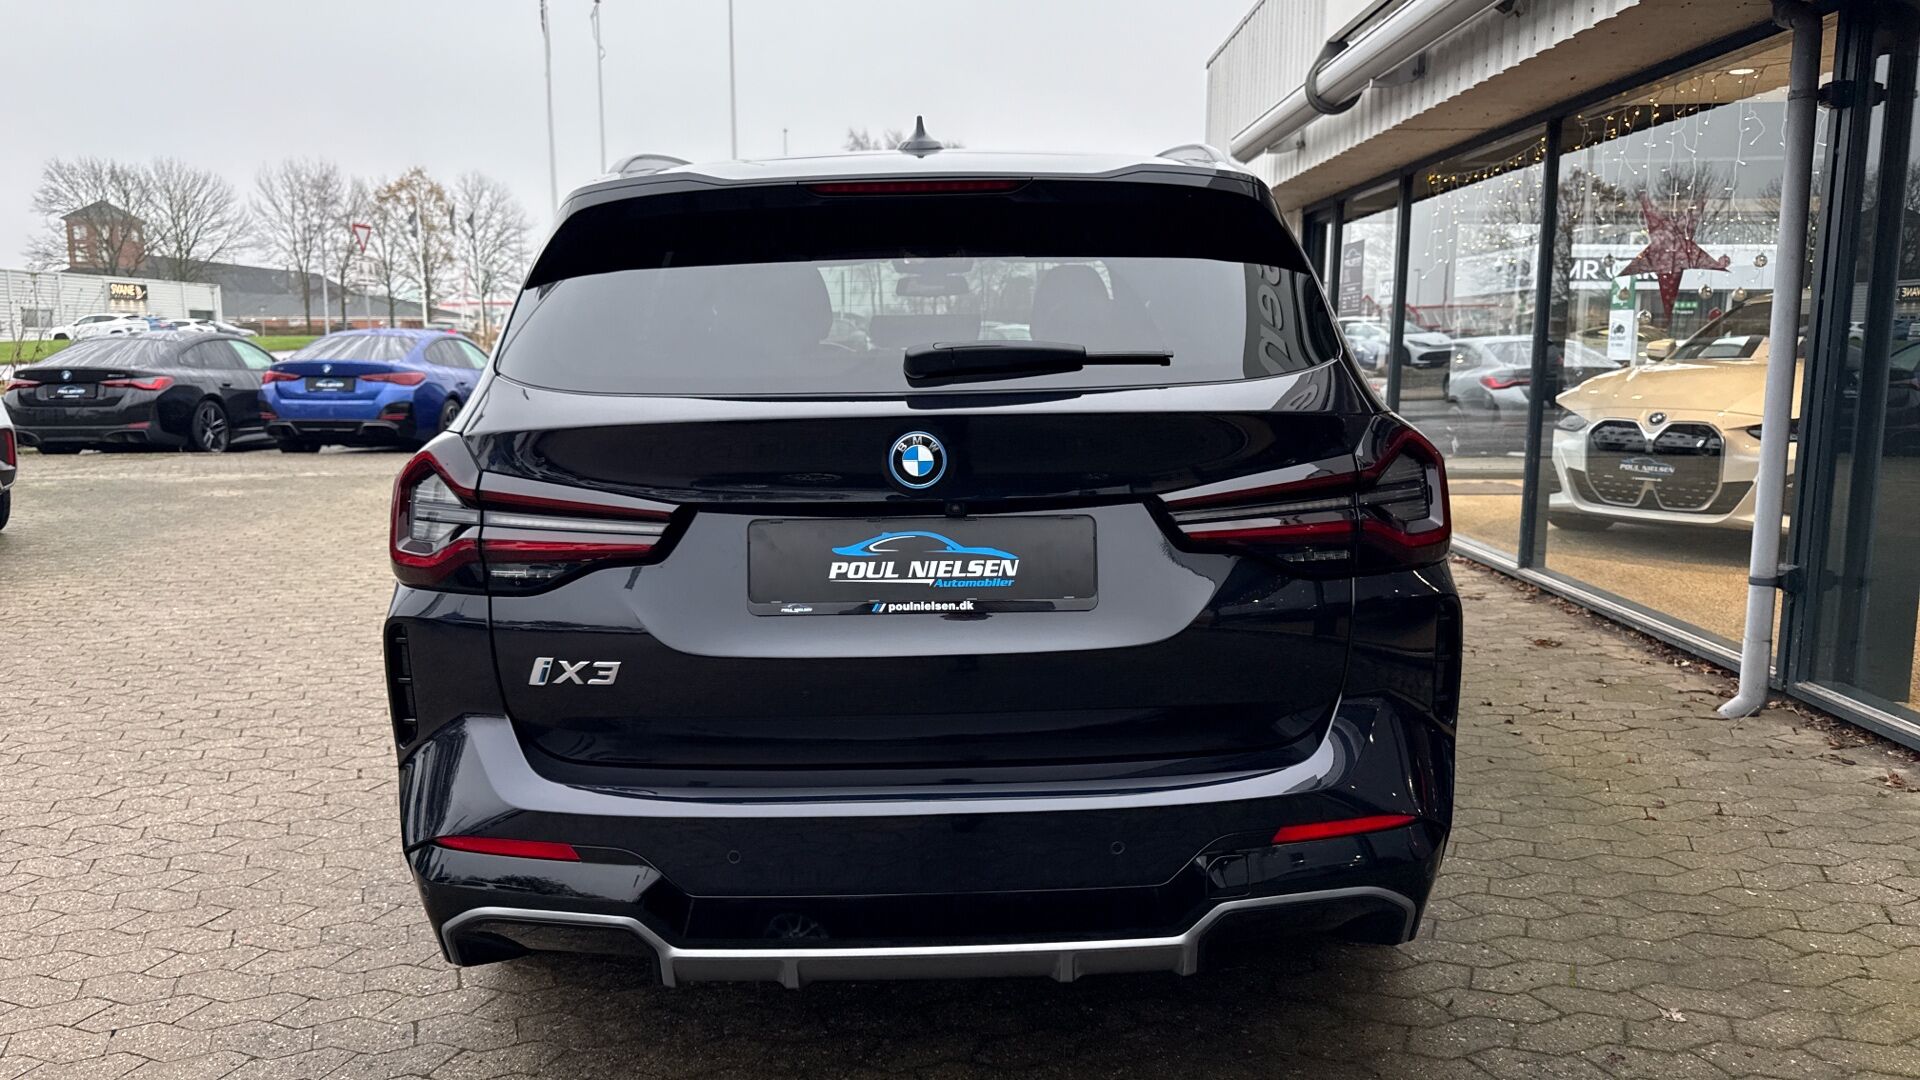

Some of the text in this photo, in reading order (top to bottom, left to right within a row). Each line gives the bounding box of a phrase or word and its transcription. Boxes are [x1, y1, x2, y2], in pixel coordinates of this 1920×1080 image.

[897, 436, 939, 453] BMW
[828, 560, 1019, 579] POUL NIELSEN
[934, 578, 1015, 588] Automobiler
[888, 601, 974, 613] poulnielsen.dk
[528, 657, 622, 686] iX3
